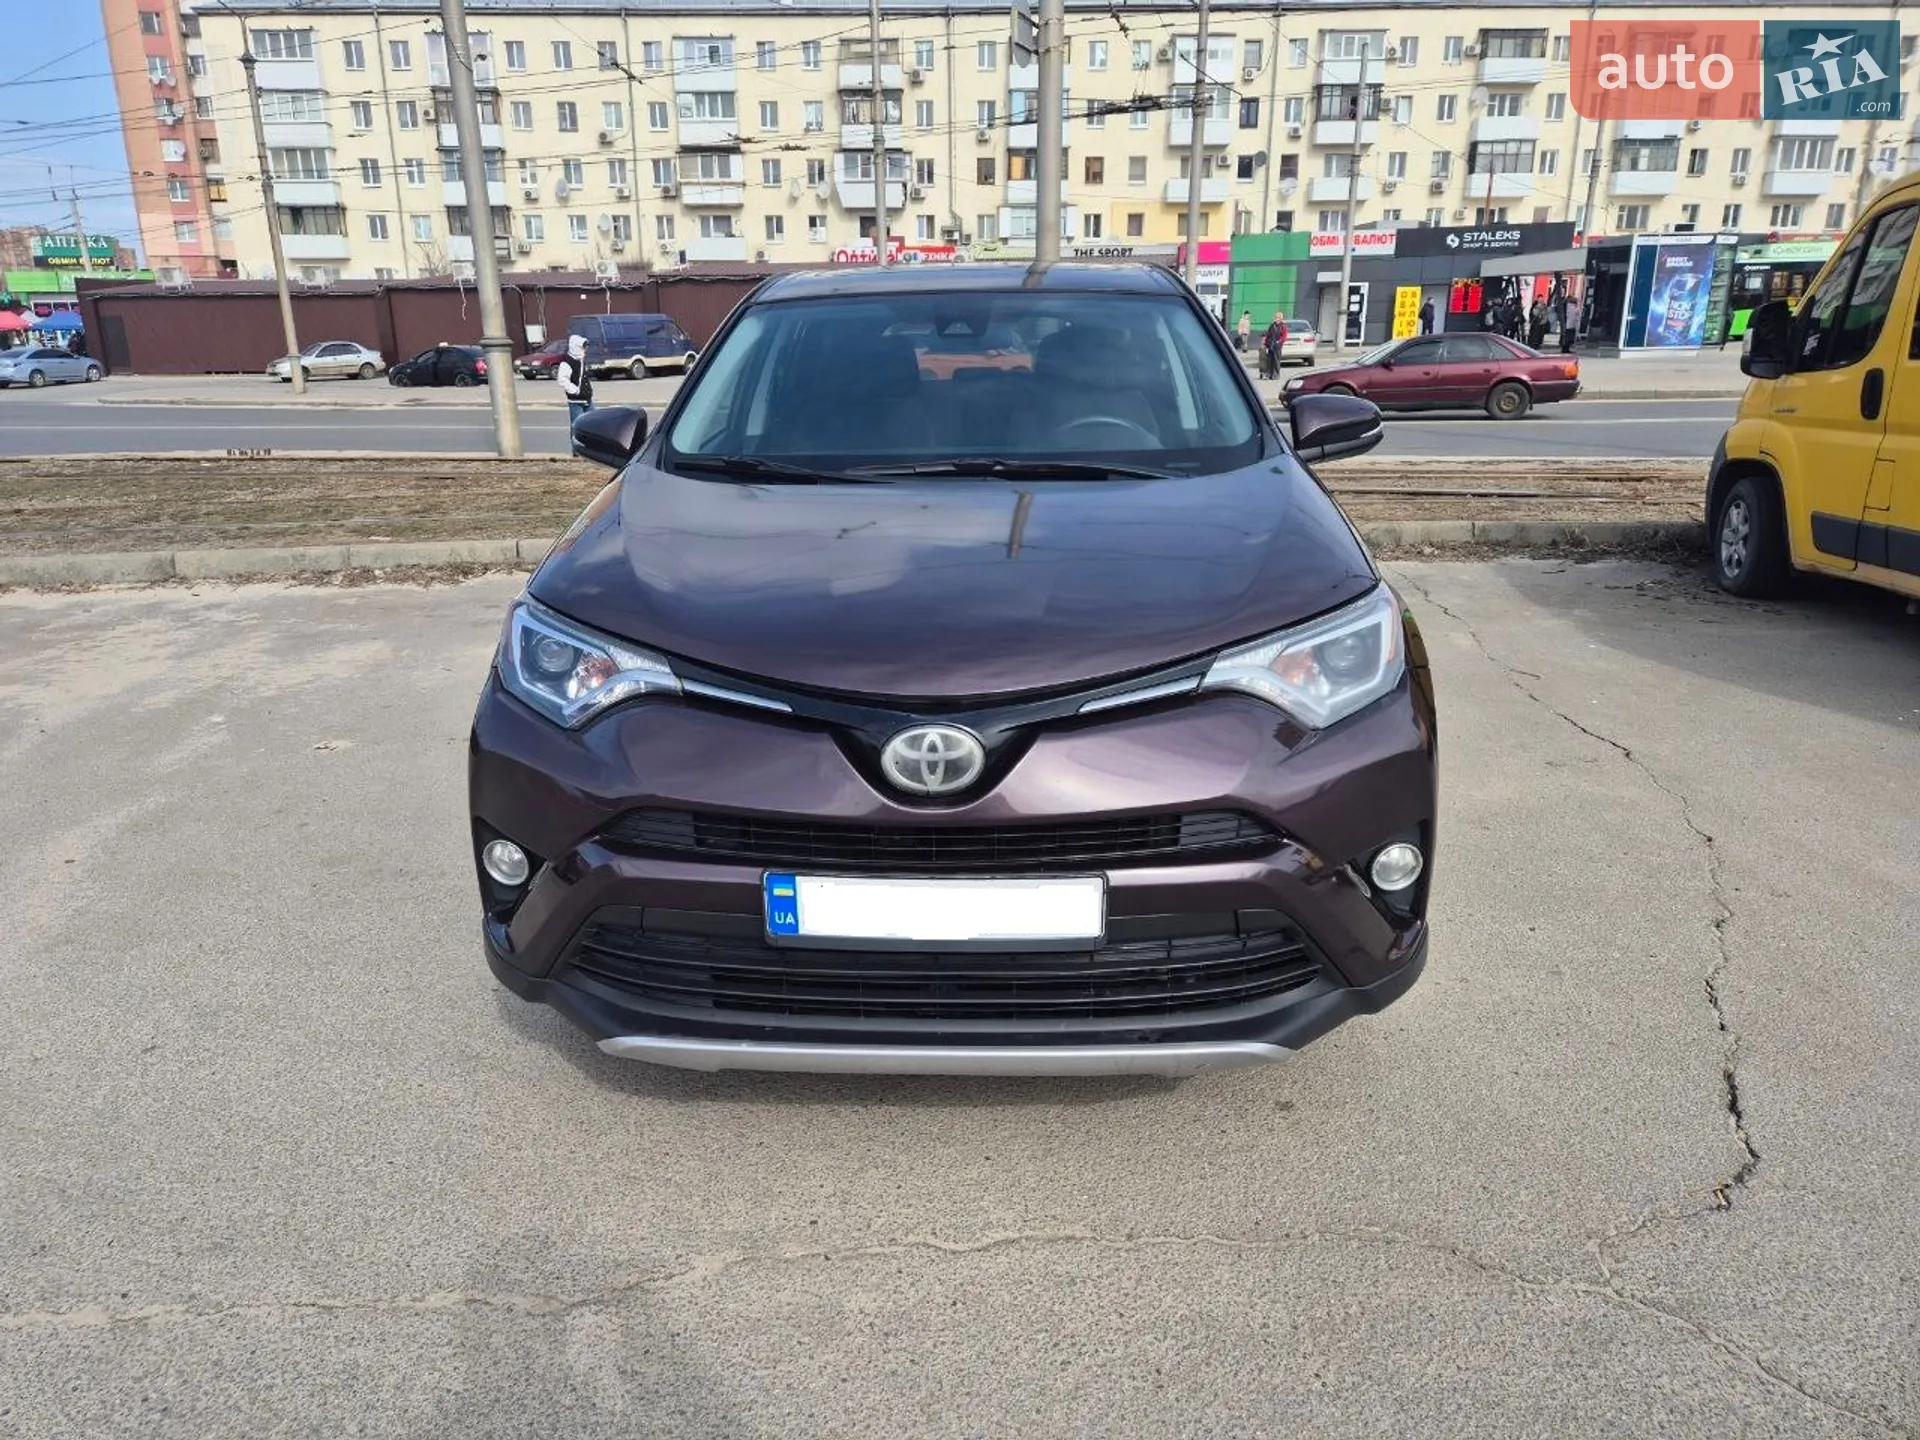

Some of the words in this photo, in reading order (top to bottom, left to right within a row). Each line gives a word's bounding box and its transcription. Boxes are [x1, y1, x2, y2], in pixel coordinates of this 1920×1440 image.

[44, 235, 108, 248] АПТКА
[1312, 235, 1344, 246] ОБМІ
[1353, 233, 1396, 246] ВАЛЮТ
[1463, 230, 1521, 242] STALEKS
[836, 249, 895, 264] Оптиа
[1074, 248, 1094, 257] THE
[1098, 247, 1134, 257] SPORT
[79, 256, 112, 265] ВЛЮТ
[774, 912, 796, 925] UA
